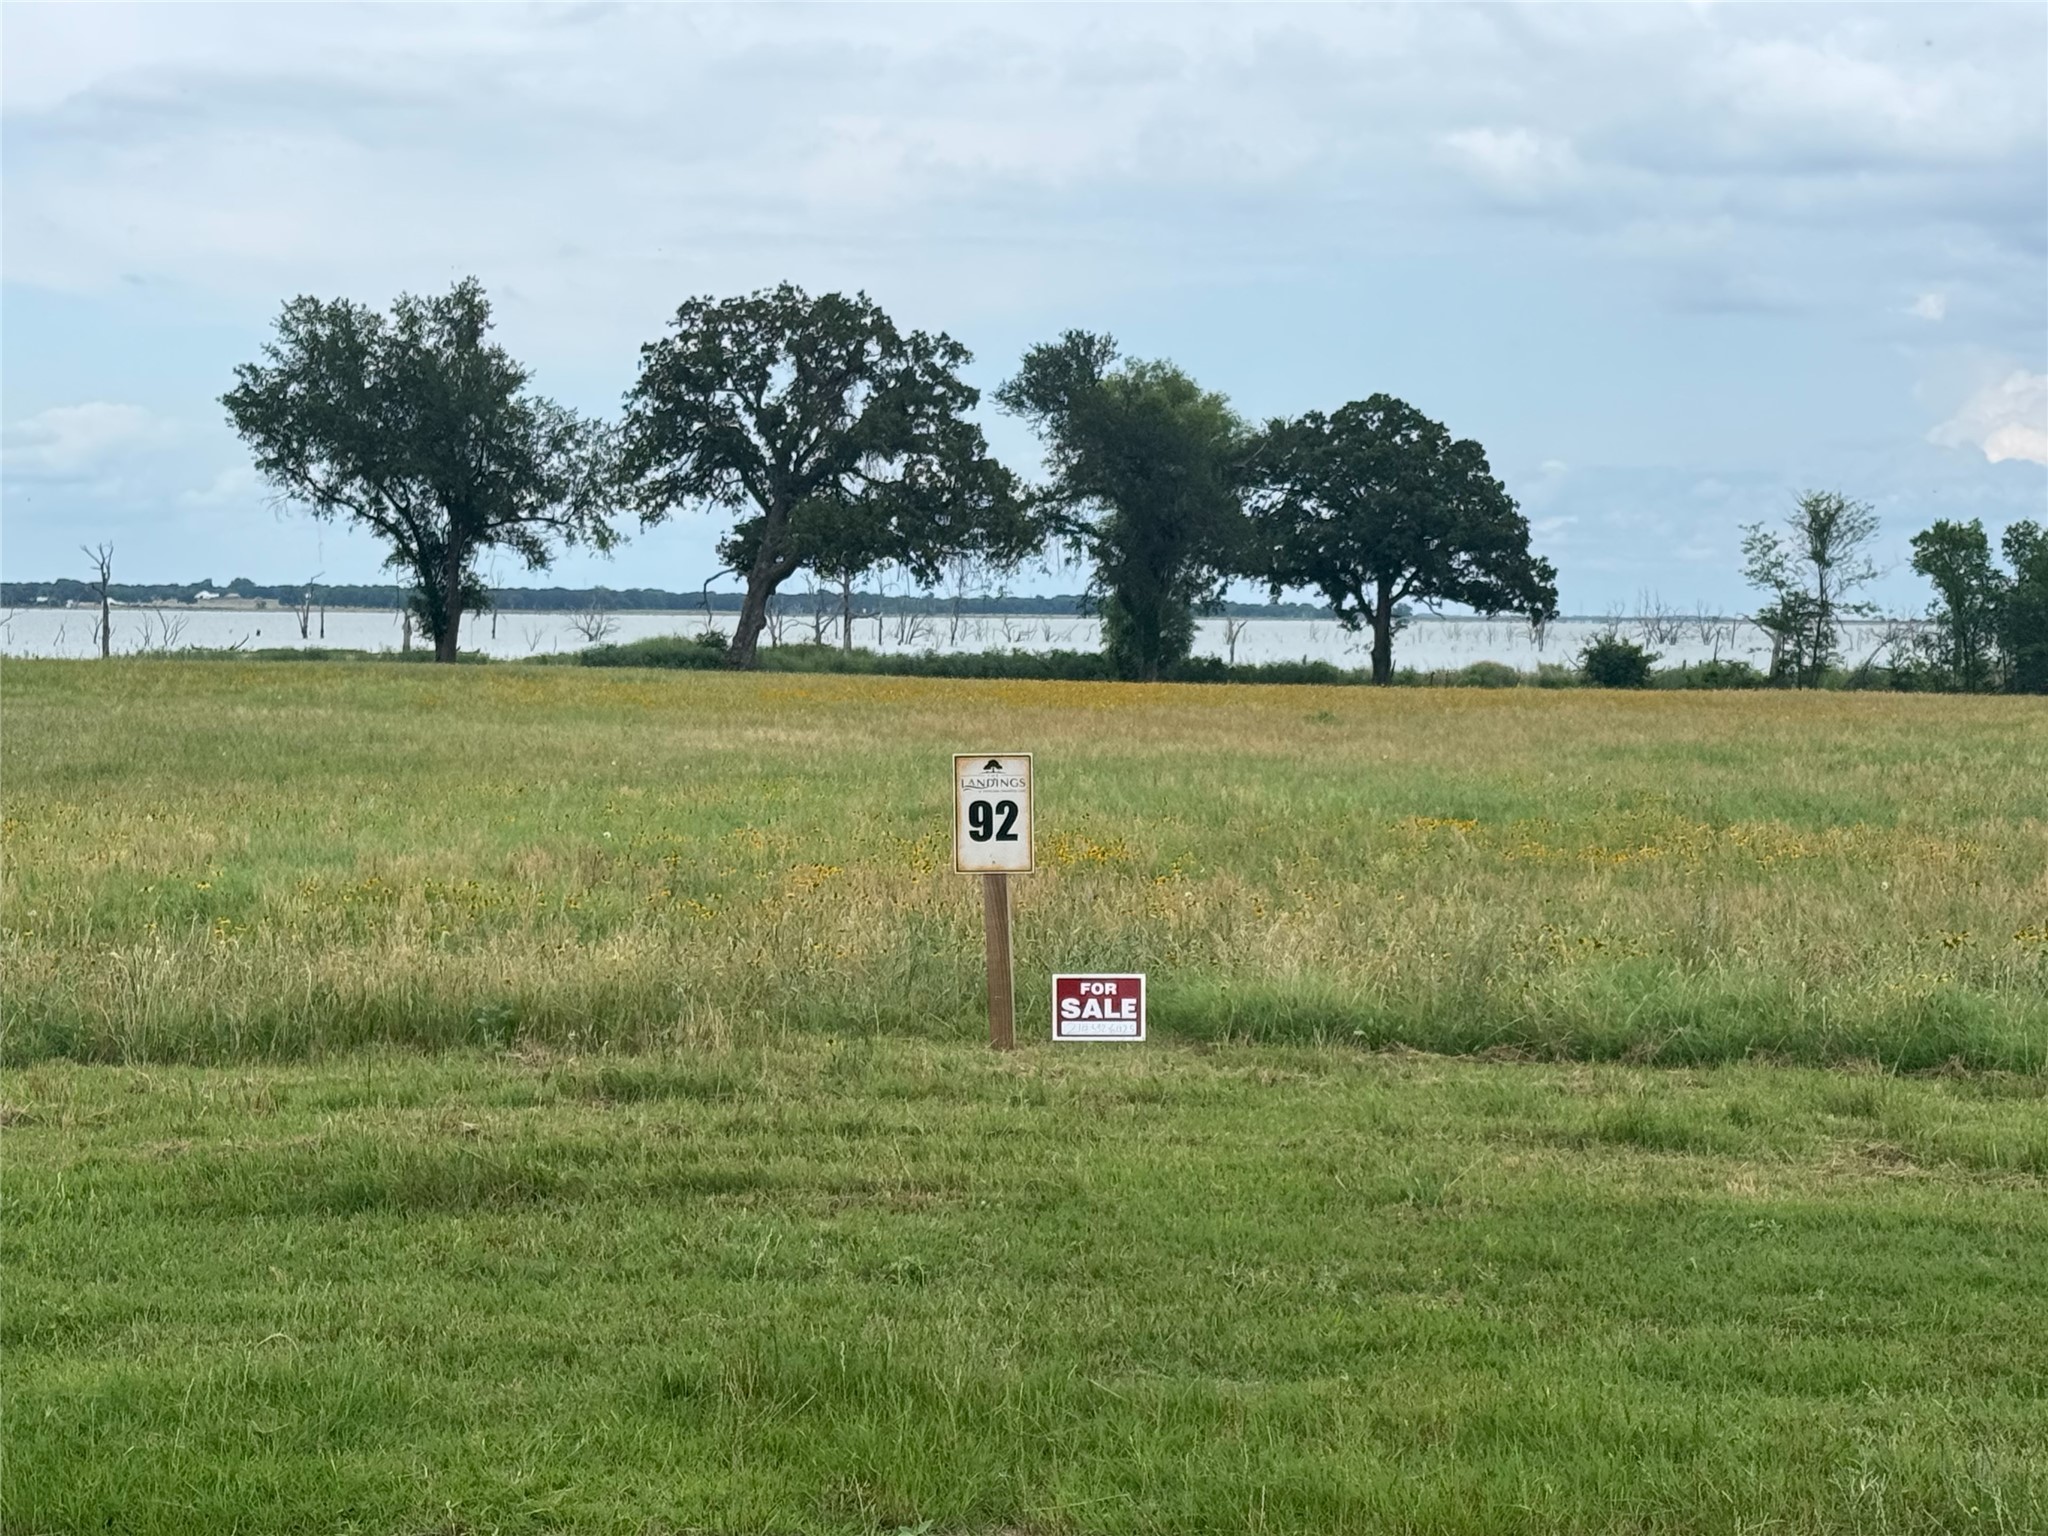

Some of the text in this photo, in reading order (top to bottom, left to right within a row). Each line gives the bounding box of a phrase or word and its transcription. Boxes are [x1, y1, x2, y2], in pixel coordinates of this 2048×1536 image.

[961, 777, 1026, 789] LANDINGS
[968, 799, 1019, 842] 92
[1080, 982, 1117, 995] FOR
[1060, 997, 1137, 1019] SALE
